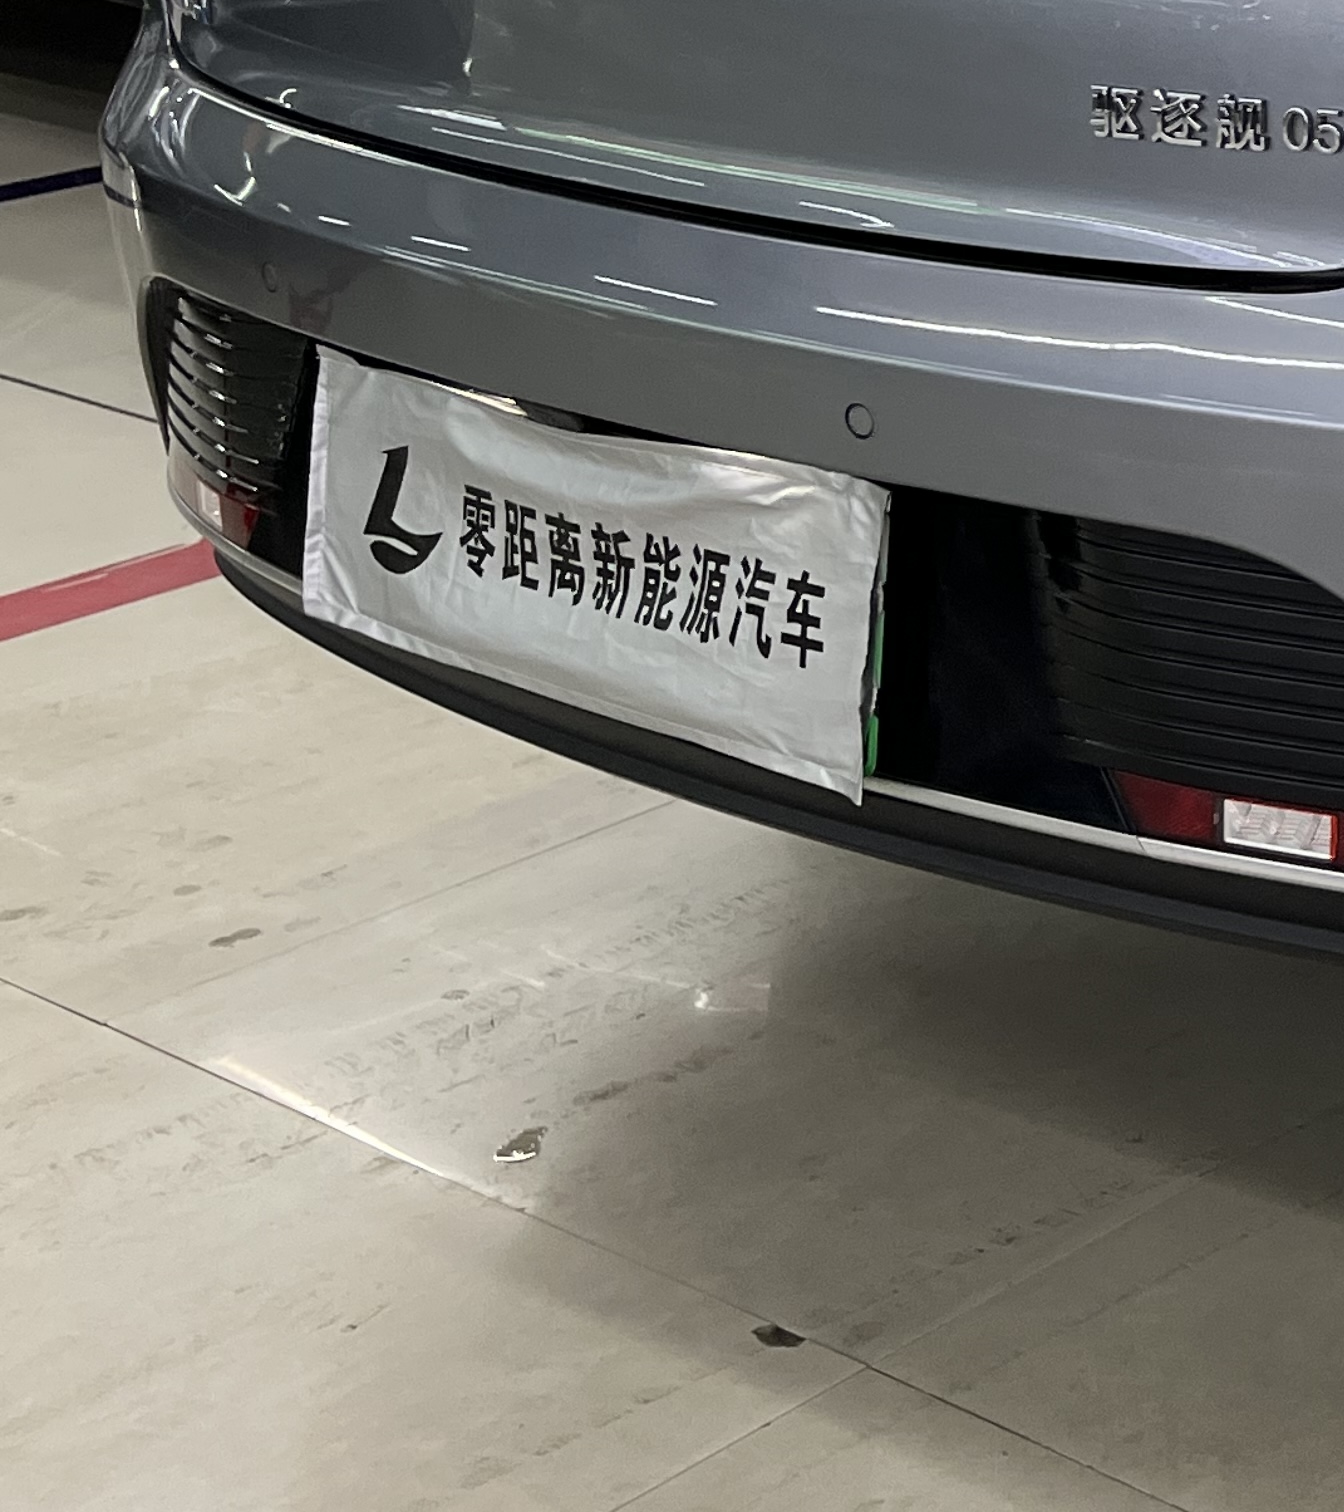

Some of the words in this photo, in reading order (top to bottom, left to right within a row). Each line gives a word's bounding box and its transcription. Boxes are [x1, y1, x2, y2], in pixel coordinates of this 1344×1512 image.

[459, 484, 826, 669] 零距离新能源汽车
